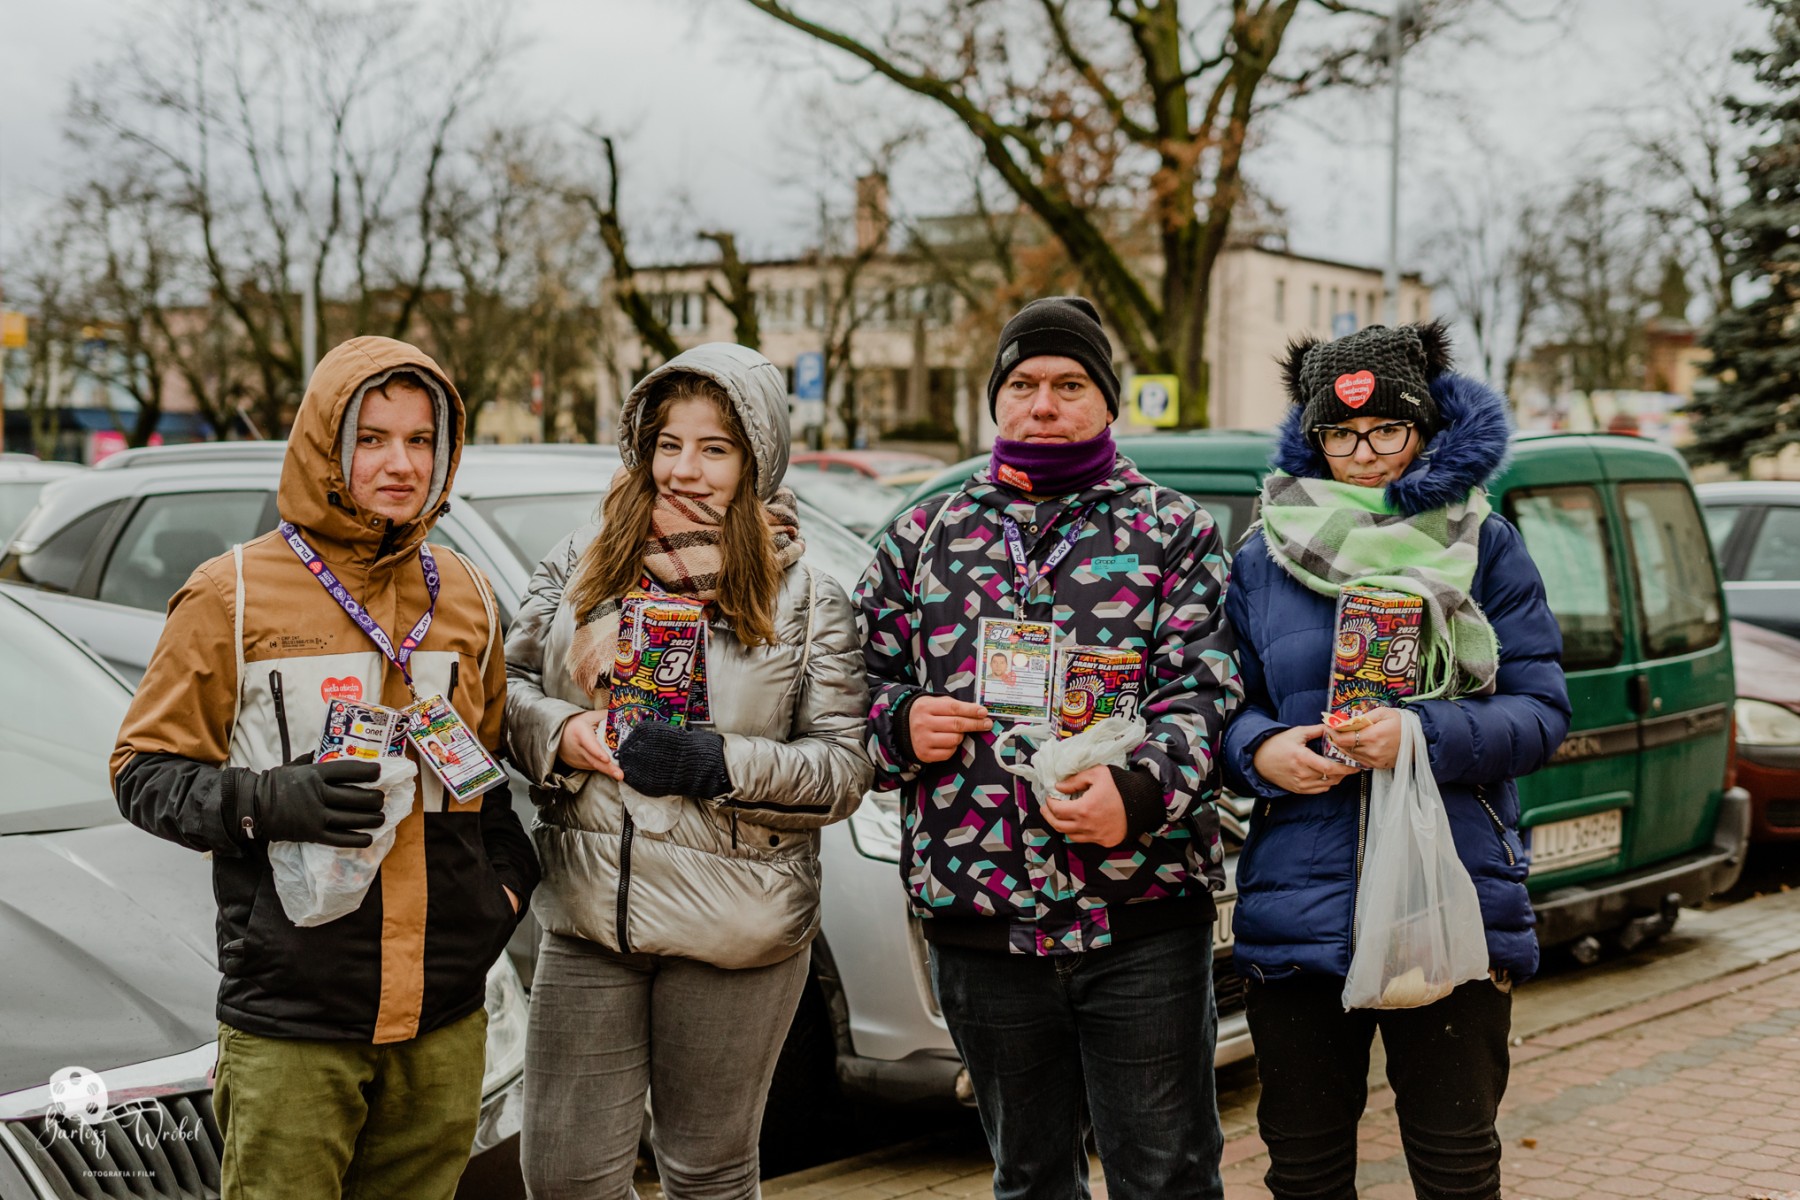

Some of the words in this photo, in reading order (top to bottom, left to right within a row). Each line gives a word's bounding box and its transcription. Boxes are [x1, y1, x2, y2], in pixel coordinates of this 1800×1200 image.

[290, 538, 311, 559] PLAY
[1011, 543, 1023, 562] PLAY
[1050, 543, 1068, 564] PLAY
[1346, 602, 1372, 611] GRAMY
[1371, 605, 1385, 614] DLA
[414, 615, 429, 639] PLAY
[645, 617, 657, 626] DLA
[990, 627, 1012, 640] 30
[1397, 626, 1419, 634] 2022
[670, 639, 694, 647] 2022
[1073, 660, 1099, 669] GRAMY
[1098, 663, 1111, 671] DLA
[1121, 682, 1139, 690] 2022
[409, 711, 422, 731] 30
[365, 727, 383, 736] onet
